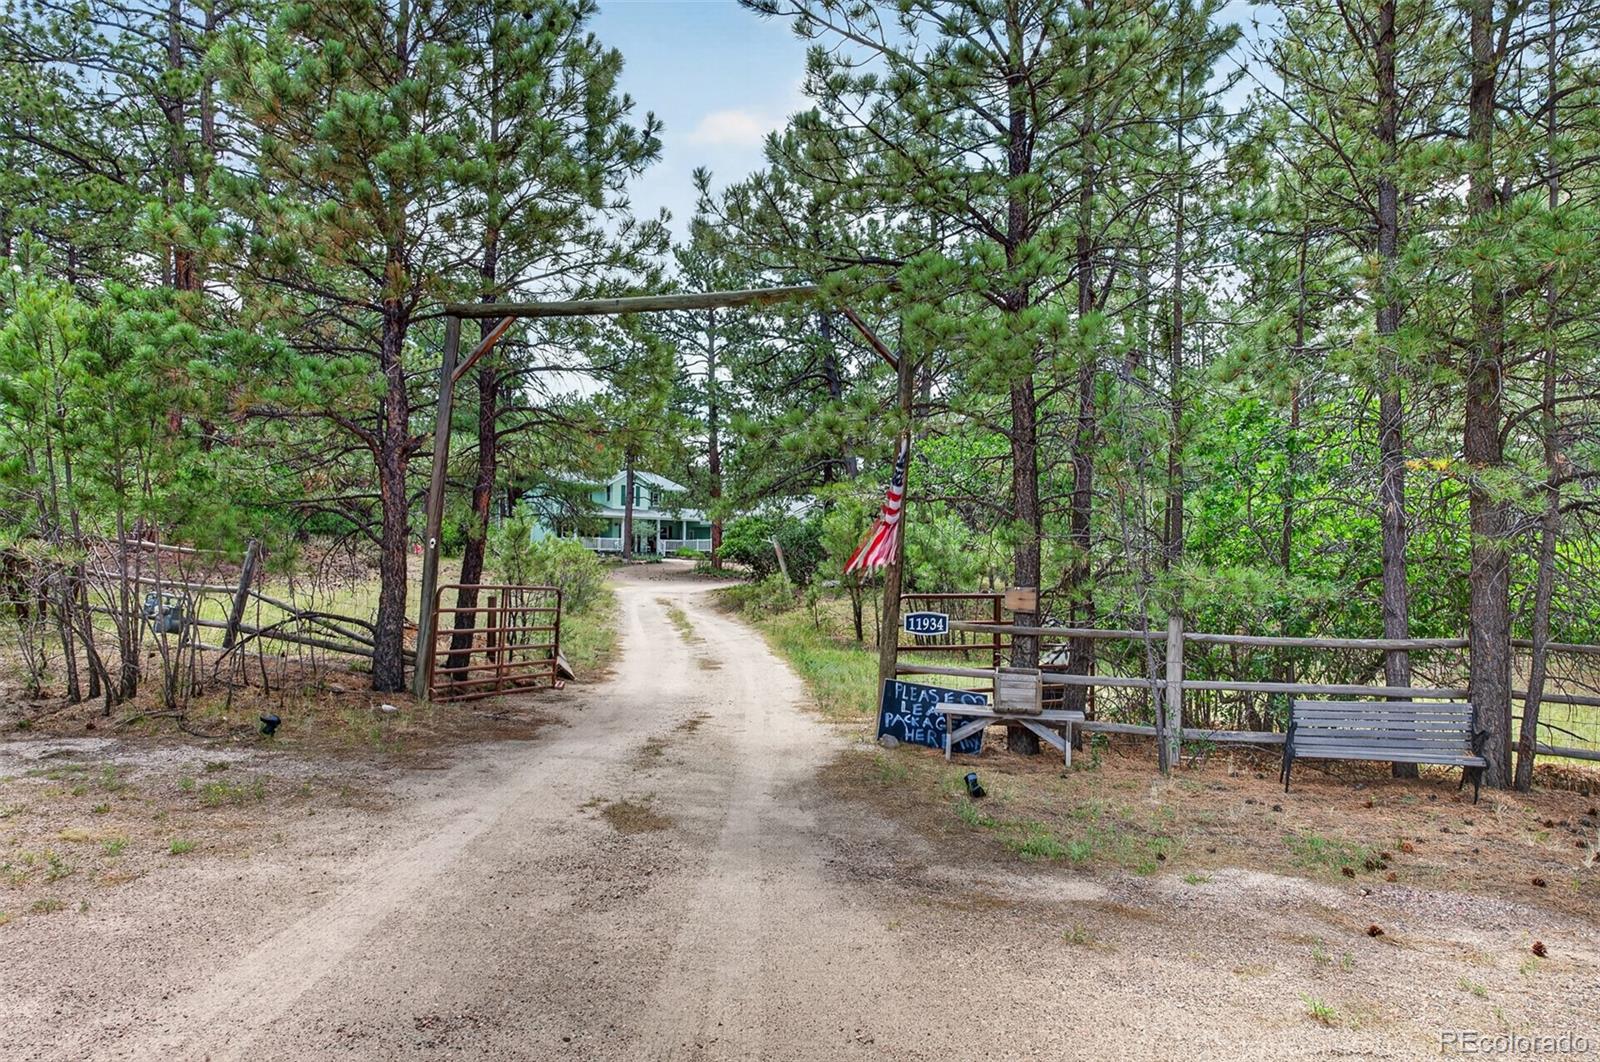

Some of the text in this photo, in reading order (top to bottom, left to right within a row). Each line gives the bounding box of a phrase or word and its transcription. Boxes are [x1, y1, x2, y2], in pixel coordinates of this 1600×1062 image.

[908, 617, 944, 631] 11934
[895, 682, 954, 704] PLEASE
[901, 701, 944, 716] LEA
[884, 712, 971, 731] PACKAG
